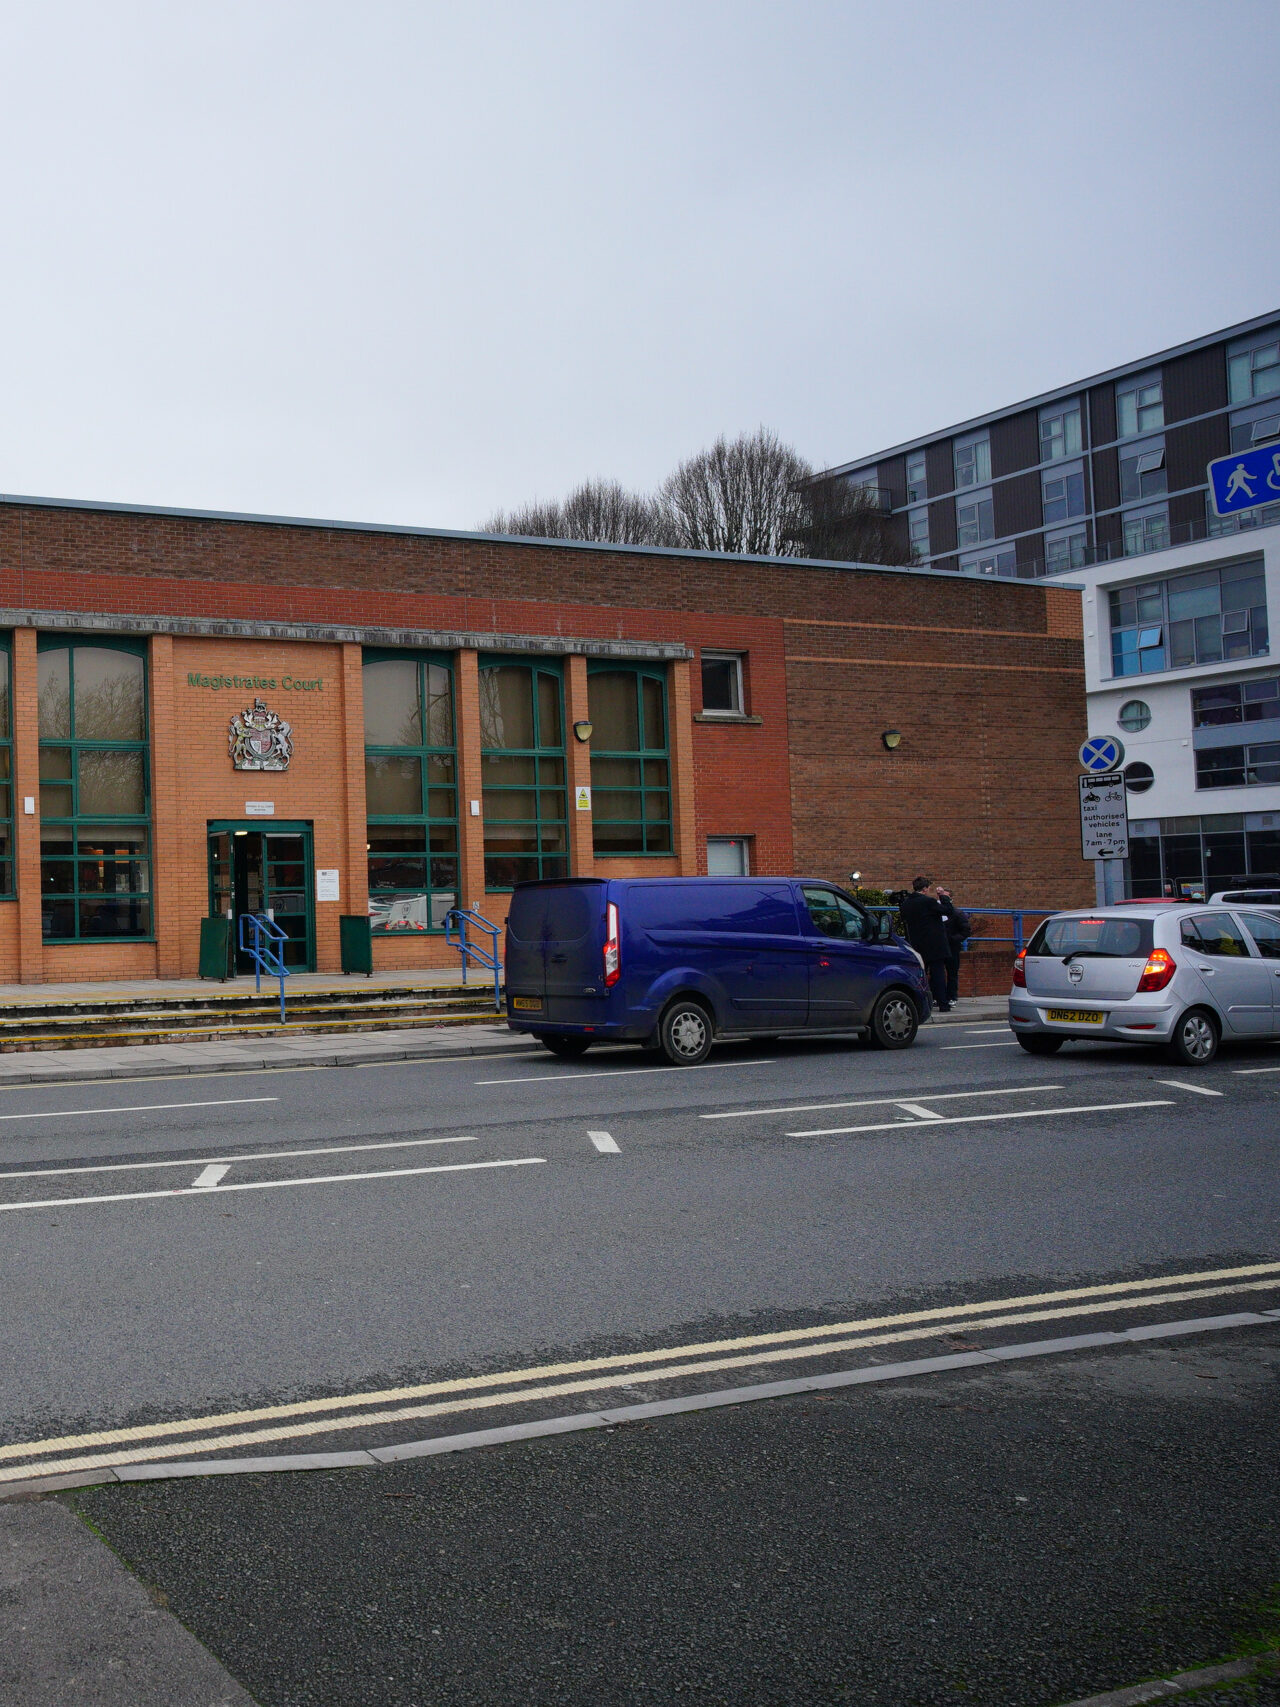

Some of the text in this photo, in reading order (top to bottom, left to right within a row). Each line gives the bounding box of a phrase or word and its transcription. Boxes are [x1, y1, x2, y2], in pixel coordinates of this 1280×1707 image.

[187, 672, 323, 690] Magistrates Court
[1083, 813, 1125, 821] authorised
[1050, 1010, 1076, 1021] DN62
